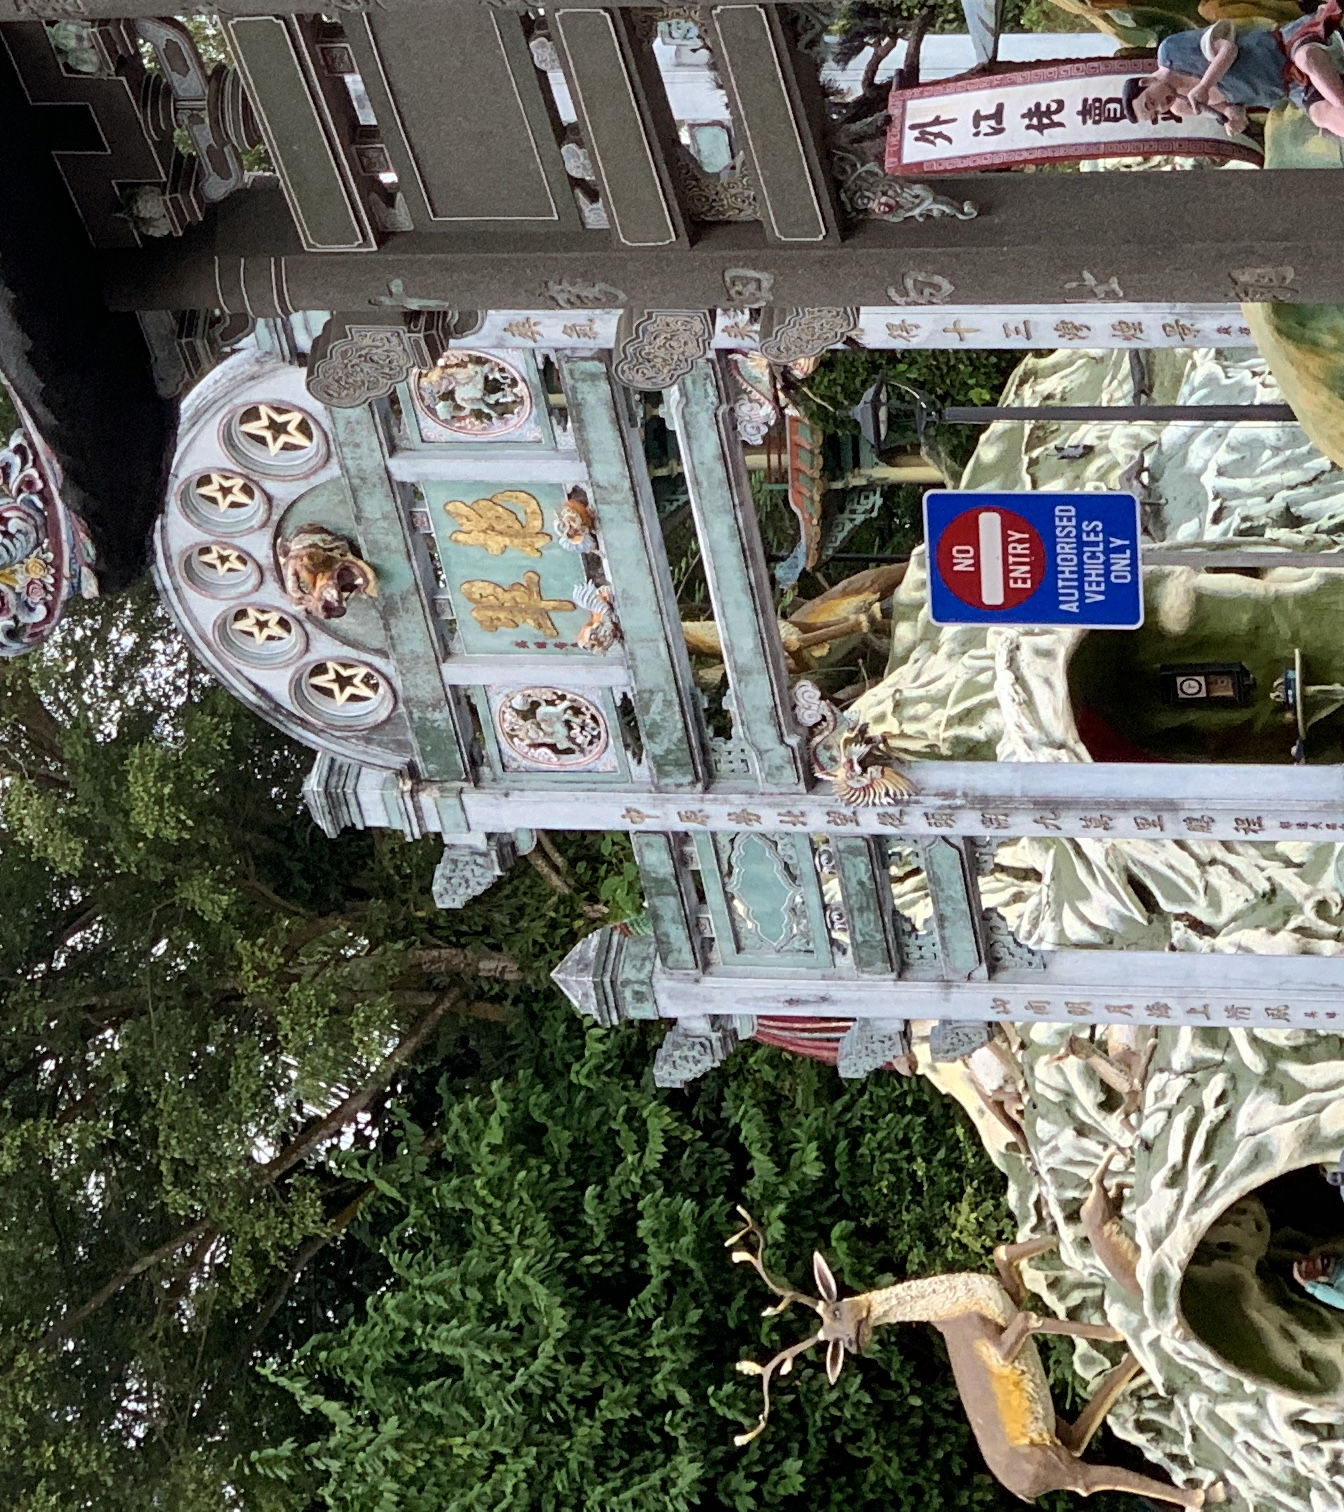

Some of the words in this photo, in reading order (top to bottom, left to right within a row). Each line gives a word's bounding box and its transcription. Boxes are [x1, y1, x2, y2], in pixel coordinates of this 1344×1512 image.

[951, 544, 976, 572] NO
[1006, 529, 1032, 589] ENTRY
[1054, 504, 1081, 613] AUTHORISED
[1081, 519, 1106, 604] VEHICLES
[1108, 536, 1132, 584] ONLY
